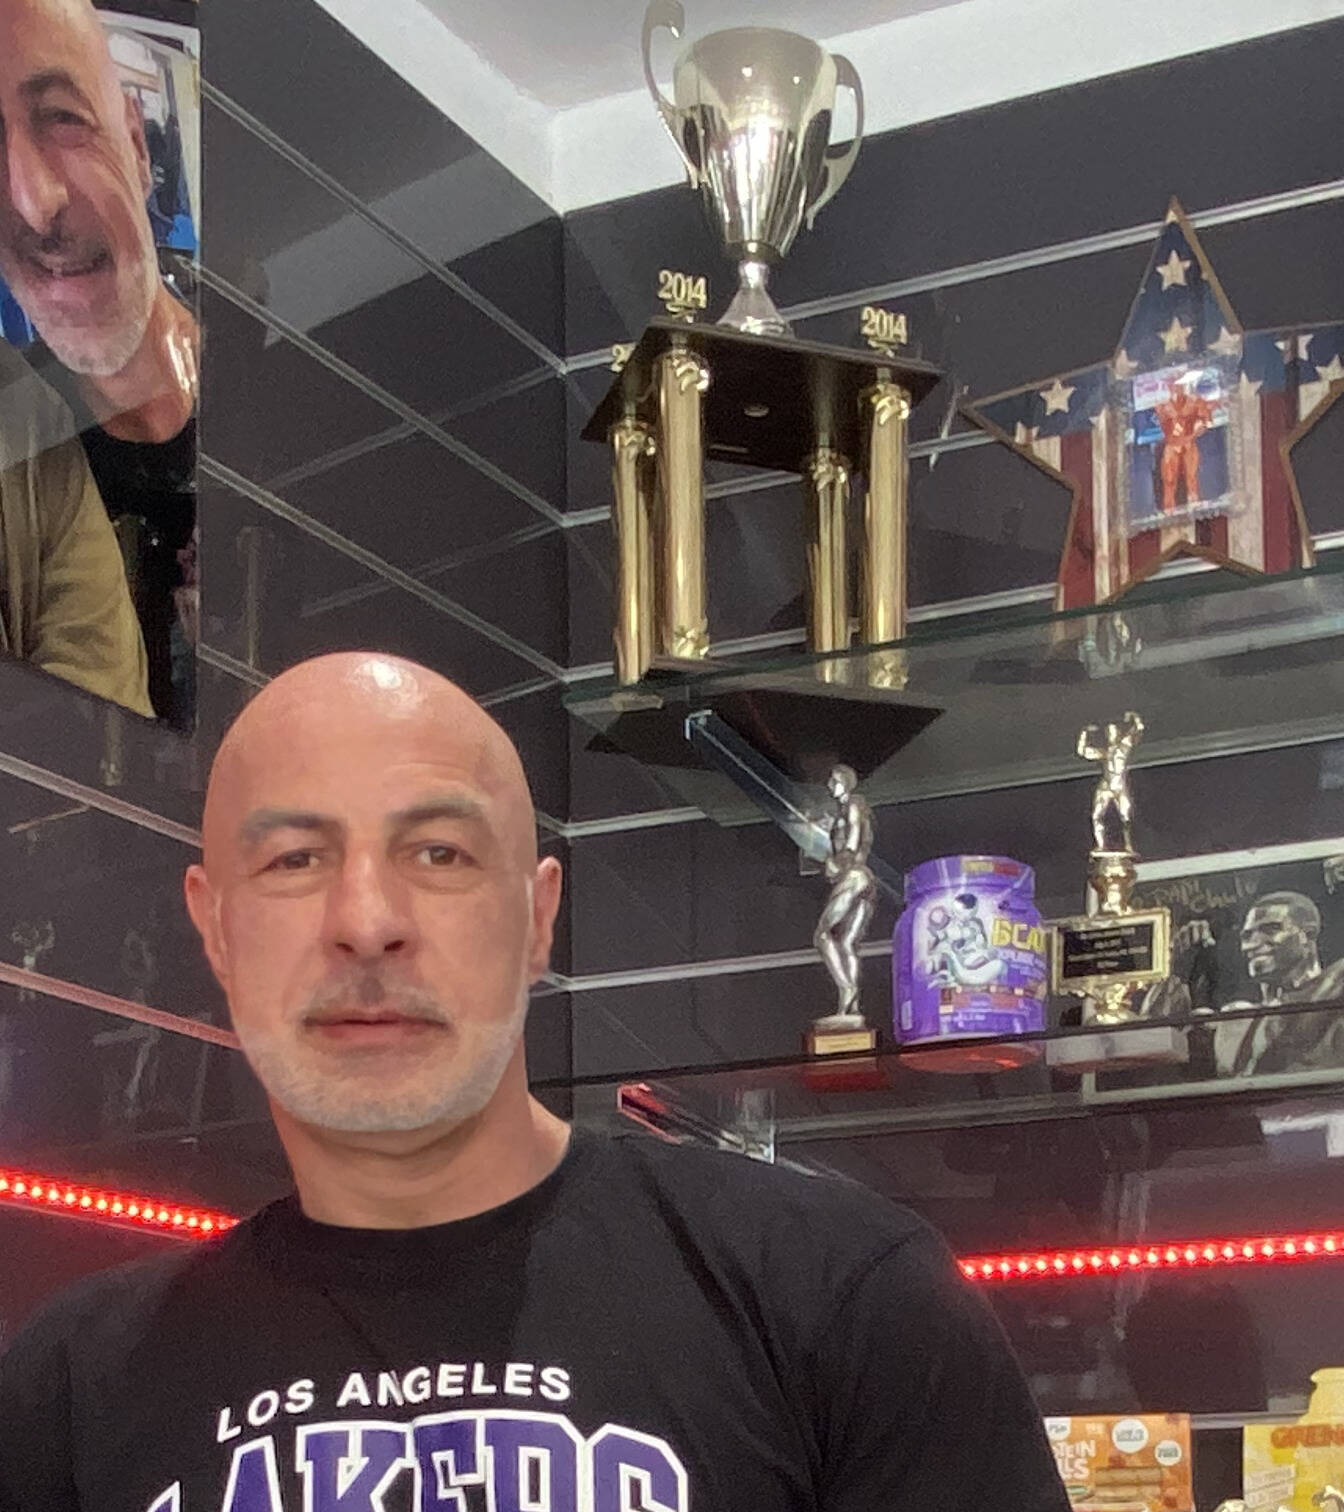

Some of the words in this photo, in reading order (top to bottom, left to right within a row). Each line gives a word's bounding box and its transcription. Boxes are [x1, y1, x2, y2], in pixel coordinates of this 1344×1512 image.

[657, 269, 706, 308] 2014
[861, 306, 907, 344] 2014
[216, 1377, 316, 1443] LOS
[336, 1361, 572, 1408] ANGELES
